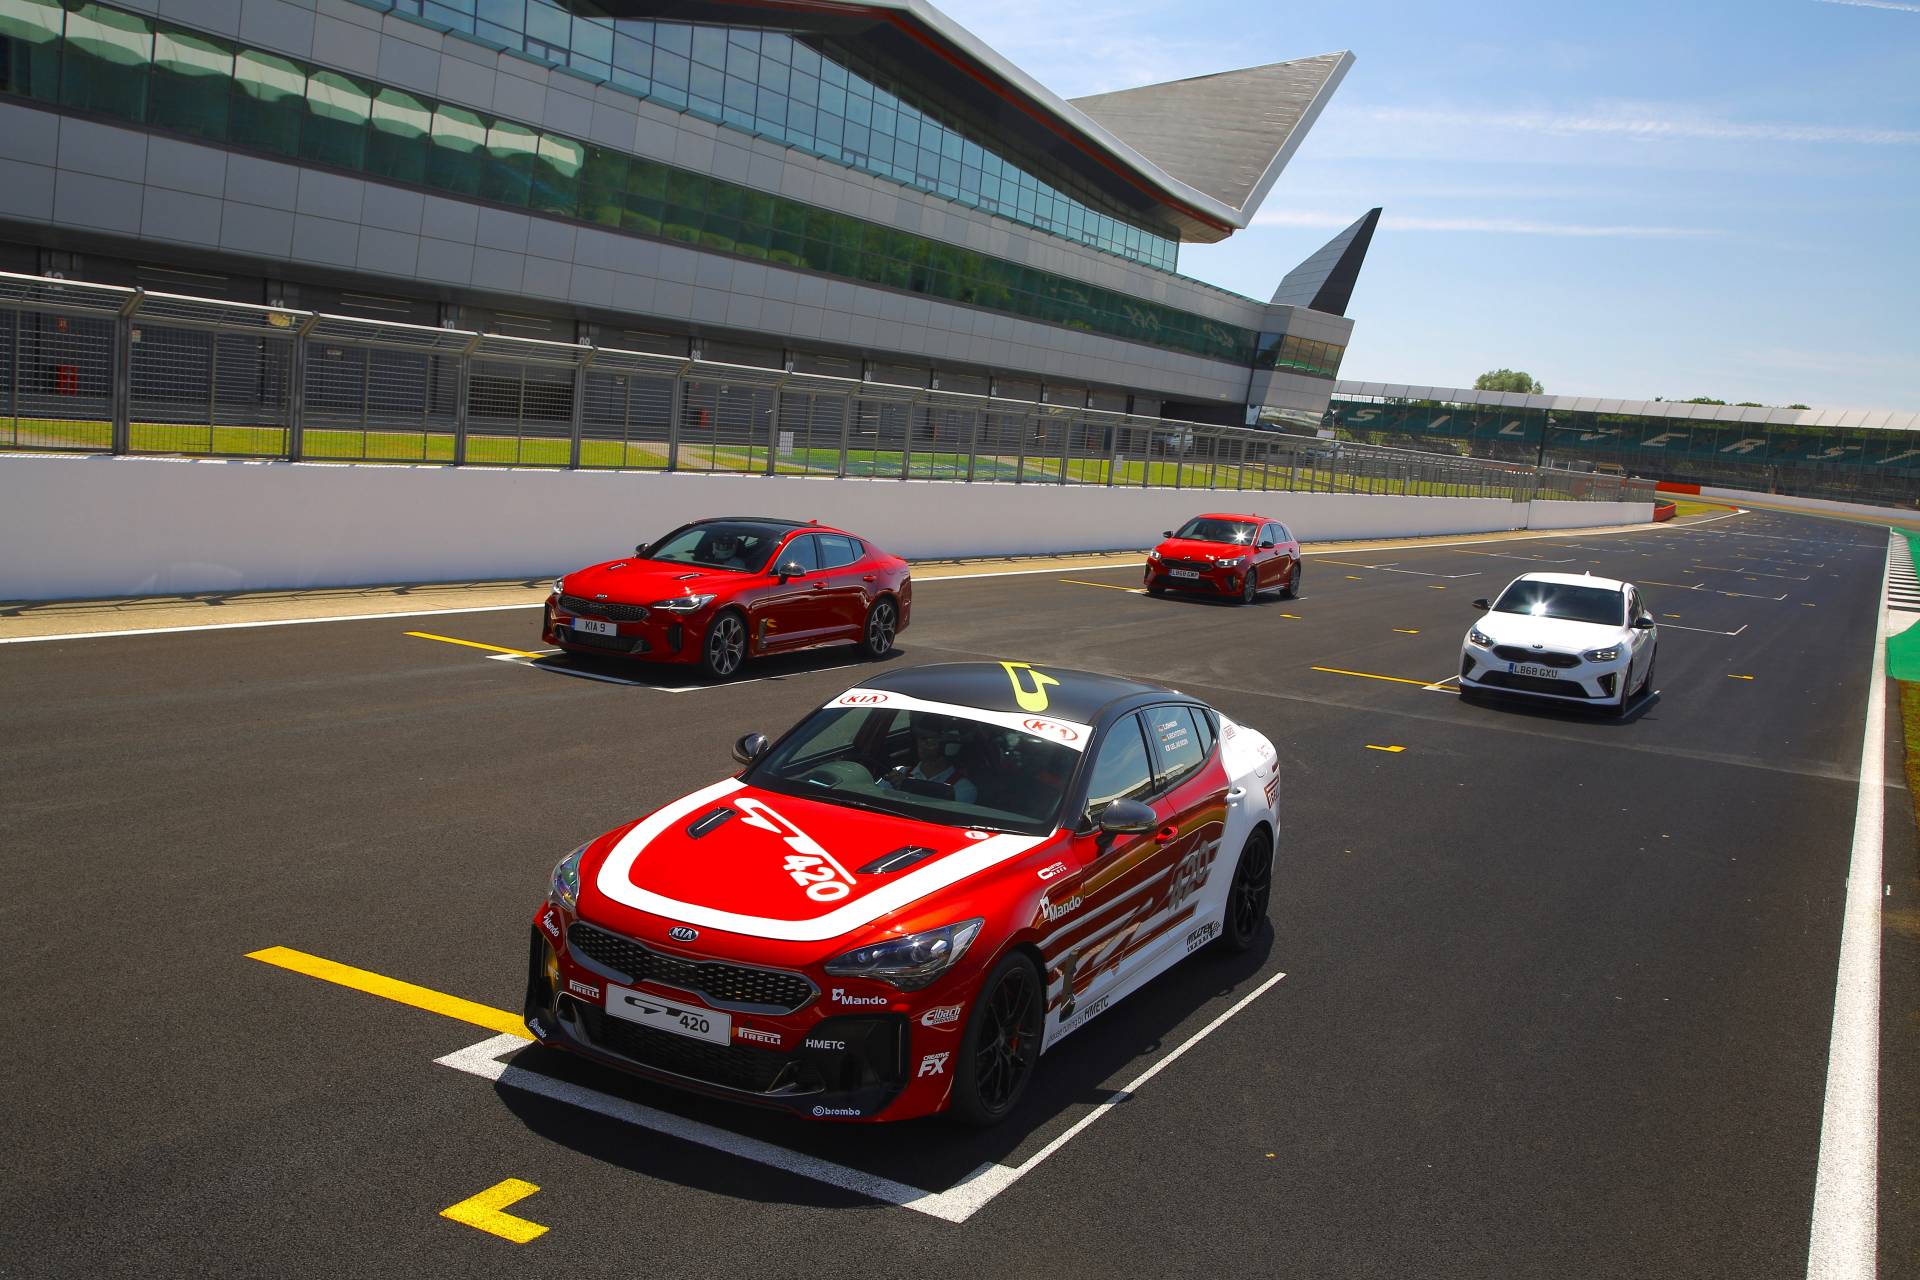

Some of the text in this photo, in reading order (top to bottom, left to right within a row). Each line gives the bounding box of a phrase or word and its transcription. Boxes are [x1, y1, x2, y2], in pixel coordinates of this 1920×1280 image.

[585, 620, 606, 633] KIA 9
[1514, 663, 1558, 679] LB68 GXU
[782, 855, 850, 902] 420
[1048, 895, 1082, 922] Mando
[670, 926, 694, 940] KIA
[569, 979, 600, 999] PIRELLI
[841, 994, 888, 1006] Mando
[1084, 994, 1110, 1021] HMETC
[679, 1016, 710, 1034] 420
[738, 1026, 782, 1046] PIRELLI
[805, 1038, 846, 1051] HMETC
[917, 1057, 948, 1078] FX
[824, 1107, 861, 1117] brembo
